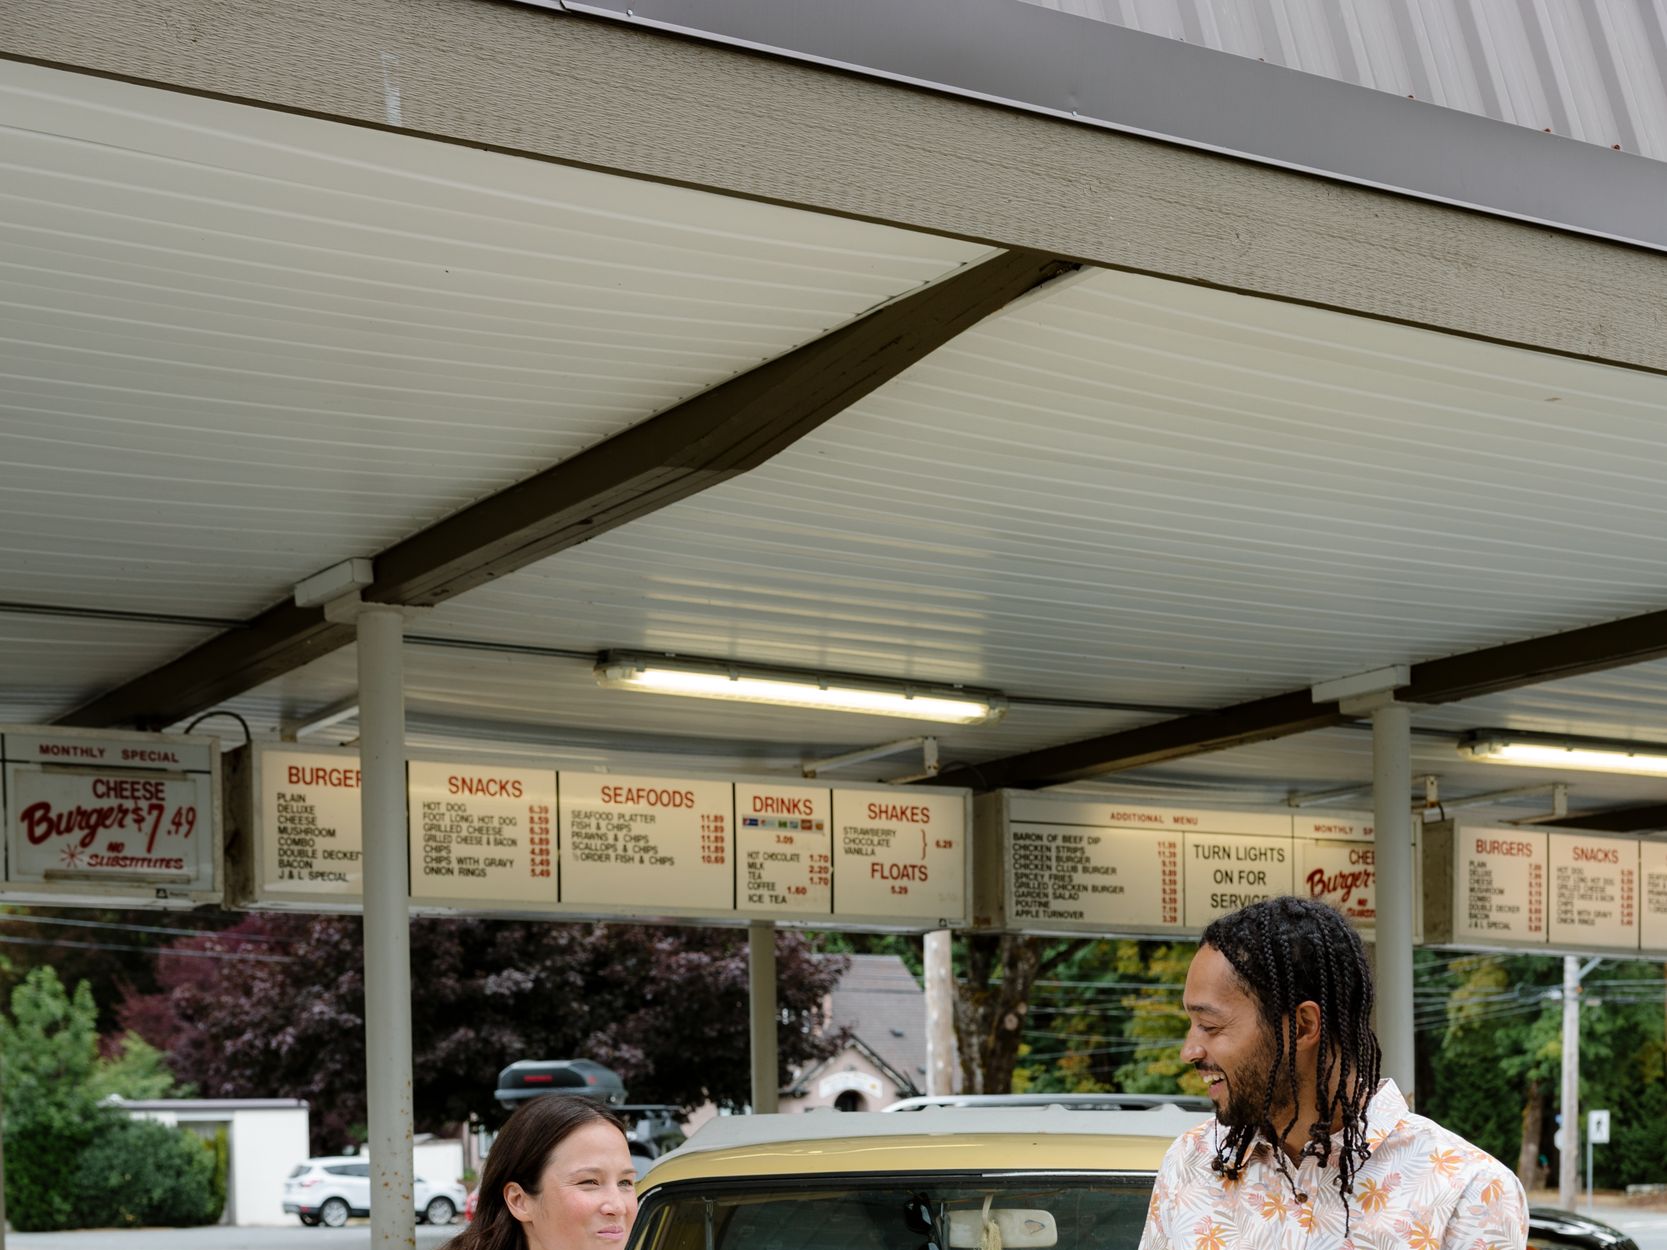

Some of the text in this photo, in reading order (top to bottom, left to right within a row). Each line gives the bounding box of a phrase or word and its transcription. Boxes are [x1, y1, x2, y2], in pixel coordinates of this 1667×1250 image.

[39, 744, 179, 763] MONTHLY SPECIAL
[92, 779, 166, 801] CHEESE
[448, 776, 523, 798] SNACKS
[277, 793, 306, 803] PLAIN
[601, 786, 695, 808] SEAFOODS
[277, 803, 315, 815] DELUXE
[423, 802, 467, 813] HOT DOG
[753, 796, 813, 816] DRINKS
[571, 810, 656, 824] SEAFOOD PLATTER
[868, 803, 930, 823] SHAKES
[1110, 812, 1198, 825] ADDITIONAL MENU
[277, 814, 317, 826] CHEESE
[423, 812, 517, 827] FOOT LONG HOT DOG
[20, 800, 197, 854] Burger $7.49
[278, 826, 336, 838] MUSHROOM
[423, 823, 504, 836] GRILLED CHEESE
[571, 821, 591, 831] FISH
[605, 823, 632, 833] CHIPS
[843, 827, 896, 838] STRAWBERRY
[1314, 824, 1354, 834] MONTHLY
[278, 837, 315, 848] COMBO
[423, 834, 452, 844] GRILLED
[456, 835, 483, 846] CHEESE
[494, 838, 518, 847] BACON
[571, 831, 608, 842] PRAWNS
[623, 834, 649, 844] CHIPS
[843, 837, 891, 848] CHOCOLATE
[1013, 832, 1101, 845] BARON OF BEEF DIP
[278, 848, 318, 859] DOUBLE
[424, 844, 451, 854] CHIPS
[571, 841, 617, 852] SCALLOPS
[632, 845, 658, 855] CHIPS
[843, 847, 876, 857] VANILLA
[1013, 843, 1085, 855] CHICKEN STRIPS
[1193, 844, 1231, 861] TURN
[1236, 846, 1285, 863] LIGHTS
[1476, 839, 1532, 857] BURGERS
[580, 853, 611, 863] ORDER
[615, 855, 635, 864] FISH
[649, 856, 675, 866] CHIPS
[747, 851, 800, 863] HOT CHOCOLATE
[1013, 852, 1090, 864] CHICKEN BURGER
[1573, 846, 1619, 864] SNACKS
[87, 854, 184, 869] SUBSTITUTES
[278, 859, 313, 870] BACON
[424, 855, 515, 868] CHIPS WITH GRAVY
[747, 862, 764, 872] MILK
[424, 866, 487, 878] ONION RINGS
[871, 862, 928, 882] FLOATS
[1013, 862, 1117, 876] CHICKEN CLUB BURGER
[308, 871, 348, 882] SPECIAL
[748, 871, 762, 880] TEA
[1049, 873, 1073, 883] FRIES
[1213, 869, 1266, 886] ON FOR
[747, 882, 776, 892] COFFEE
[1014, 881, 1124, 895] GRILLED CHICKEN BURGER
[1306, 868, 1370, 902] Burger
[748, 894, 787, 904] ICE TEA
[1015, 890, 1079, 901] GARDEN SALAD
[1016, 900, 1049, 909] POUTINE
[1016, 909, 1084, 919] APPLE TURNOVER
